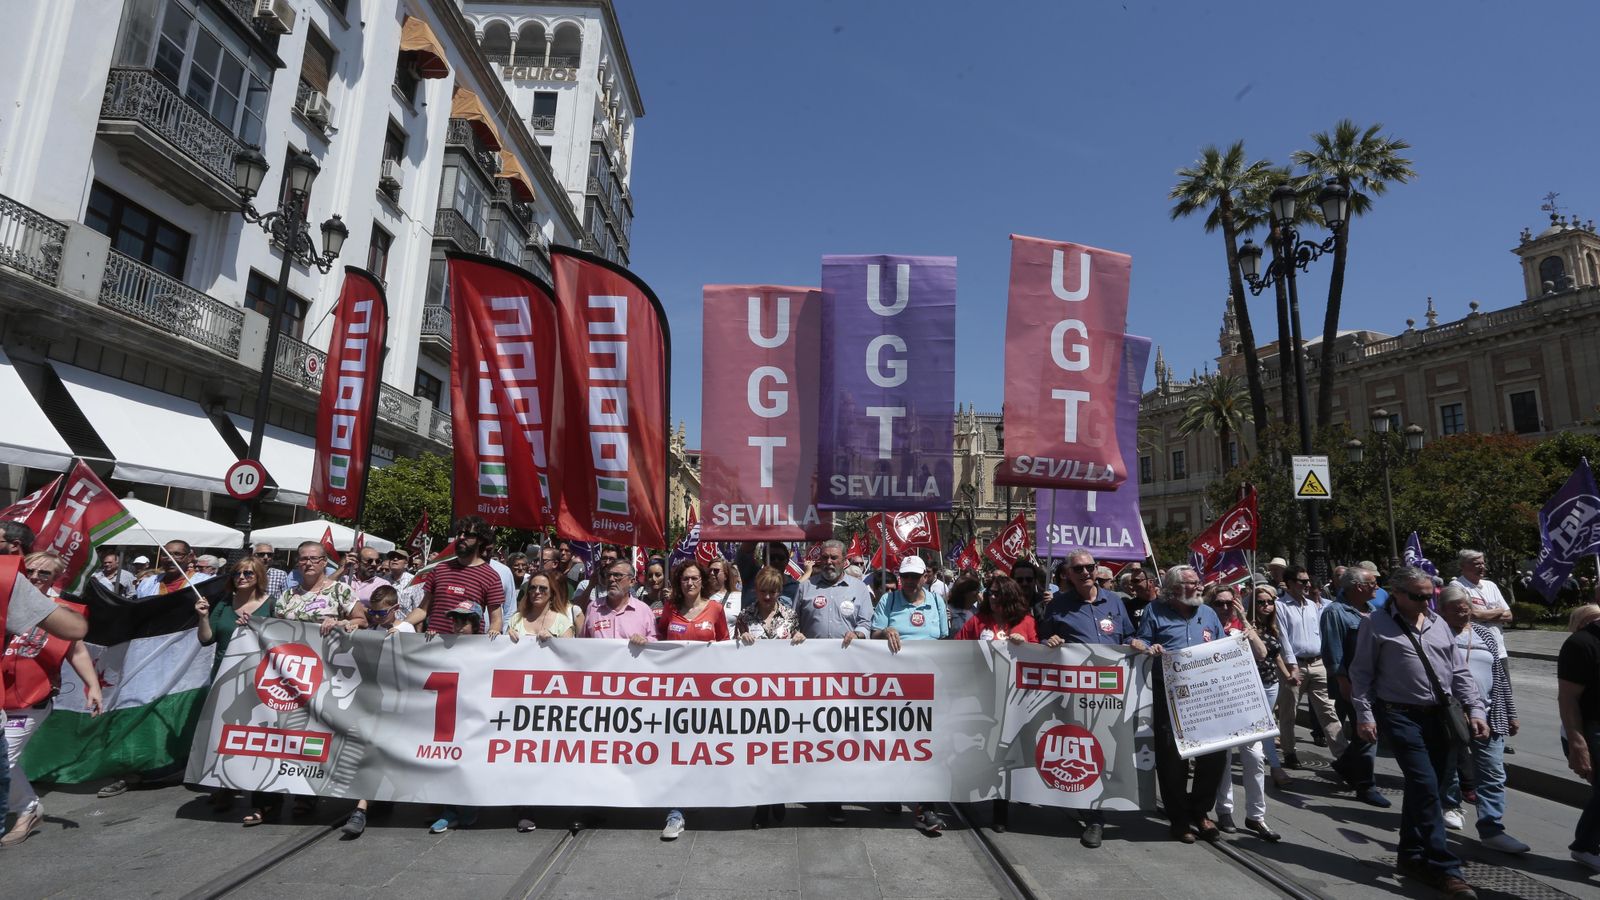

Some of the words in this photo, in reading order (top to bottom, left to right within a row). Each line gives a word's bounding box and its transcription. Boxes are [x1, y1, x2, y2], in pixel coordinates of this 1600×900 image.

[866, 263, 911, 459] UGT
[747, 296, 791, 488] UGT
[237, 472, 255, 485] 10
[1012, 454, 1116, 483] SEVILLA
[829, 474, 941, 498] SEVILLA
[712, 503, 821, 527] SEVILLA
[1046, 525, 1134, 549] SEVILLA
[264, 653, 318, 686] UGT
[1022, 667, 1097, 688] CCOO
[522, 674, 569, 695] LA
[581, 675, 700, 697] LUCHA
[710, 672, 905, 698] CONTINÚA
[267, 698, 299, 712] Sevilla
[422, 671, 460, 743] 1
[1079, 697, 1124, 710] Sevilla
[225, 730, 304, 755] CCOO
[416, 745, 463, 761] MAYO
[487, 739, 659, 765] PRIMERO
[671, 741, 735, 766] LAS
[746, 738, 933, 766] PERSONAS
[1043, 734, 1095, 763] UGT
[278, 762, 325, 779] Sevilla
[1053, 779, 1085, 792] Sevilla
